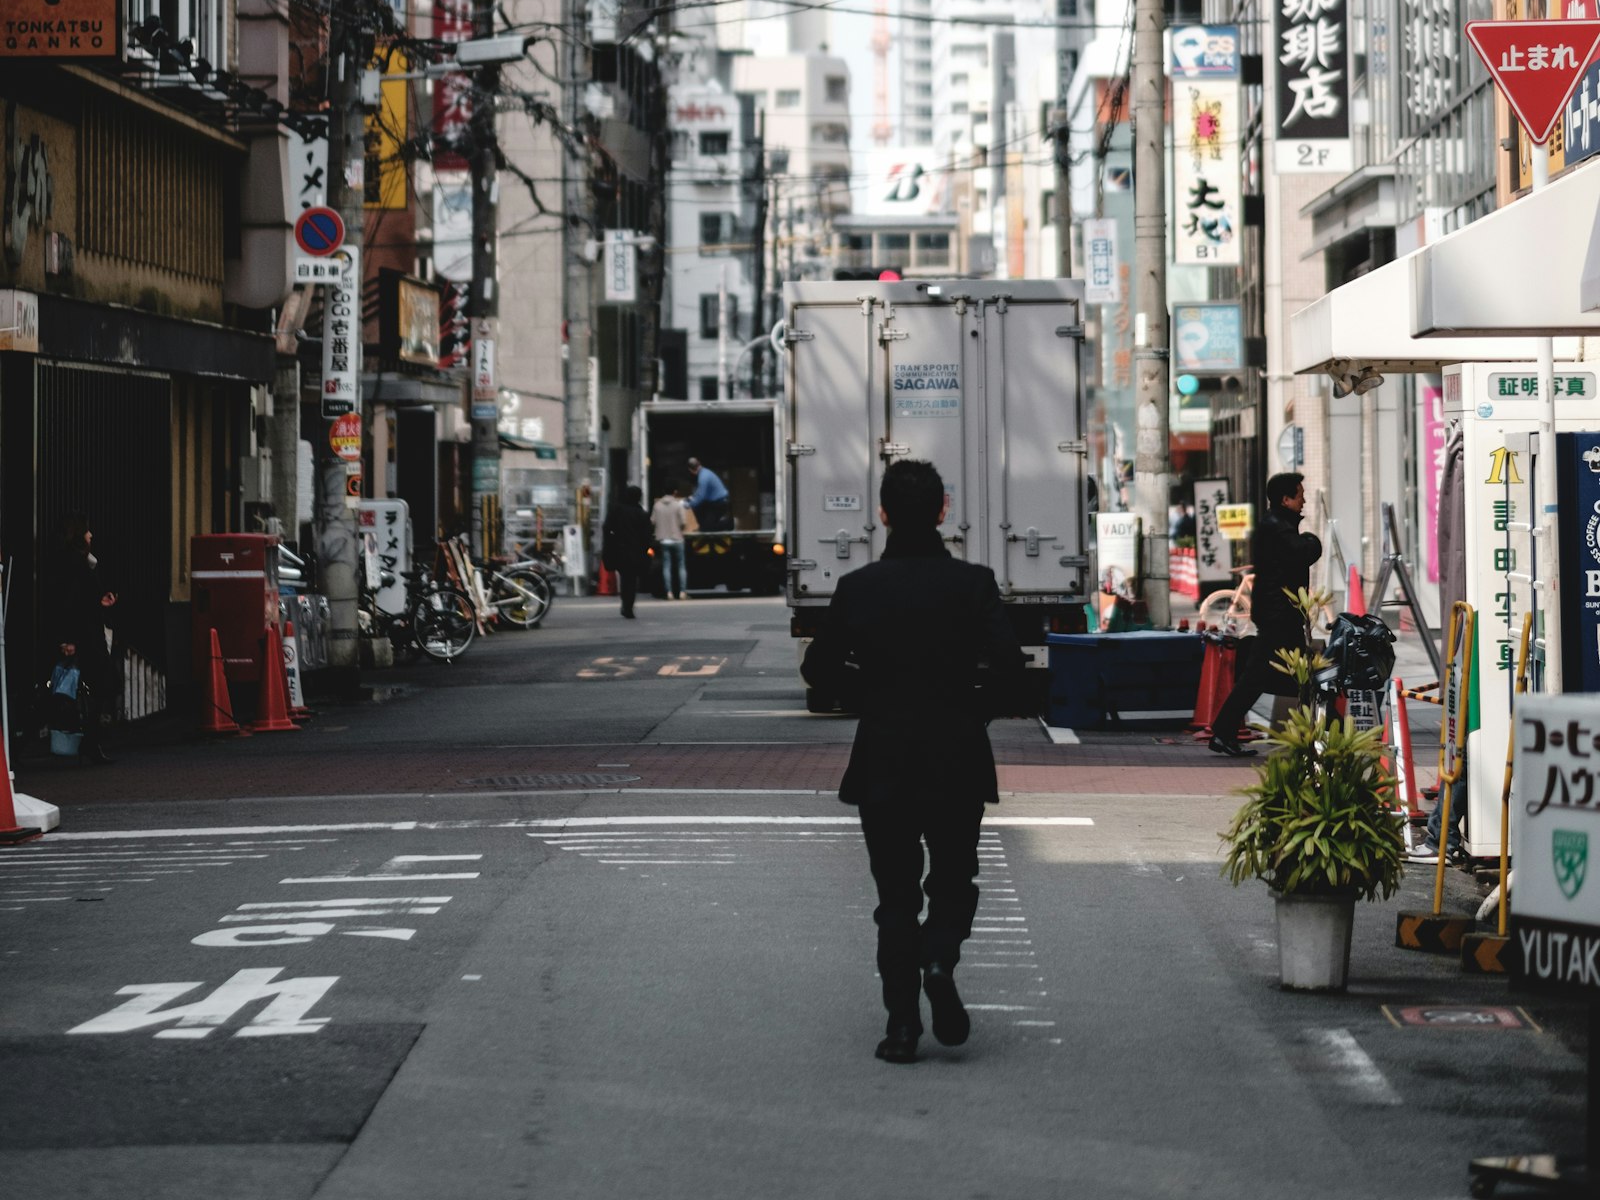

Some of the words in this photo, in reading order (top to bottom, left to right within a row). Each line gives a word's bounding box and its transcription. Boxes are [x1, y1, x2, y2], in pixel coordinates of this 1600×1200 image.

[6, 20, 103, 33] TONKATSU
[6, 35, 103, 49] GANKO
[1497, 43, 1579, 72] 止まれ
[1297, 143, 1330, 166] 2F
[298, 264, 340, 278] 自動車
[331, 319, 349, 372] 壱番屋
[894, 378, 959, 390] SAGAWA
[895, 399, 958, 409] 天然ガス自動車
[1102, 523, 1133, 535] VADY
[1586, 514, 1599, 547] COFFEE
[1526, 765, 1600, 817] ハウ
